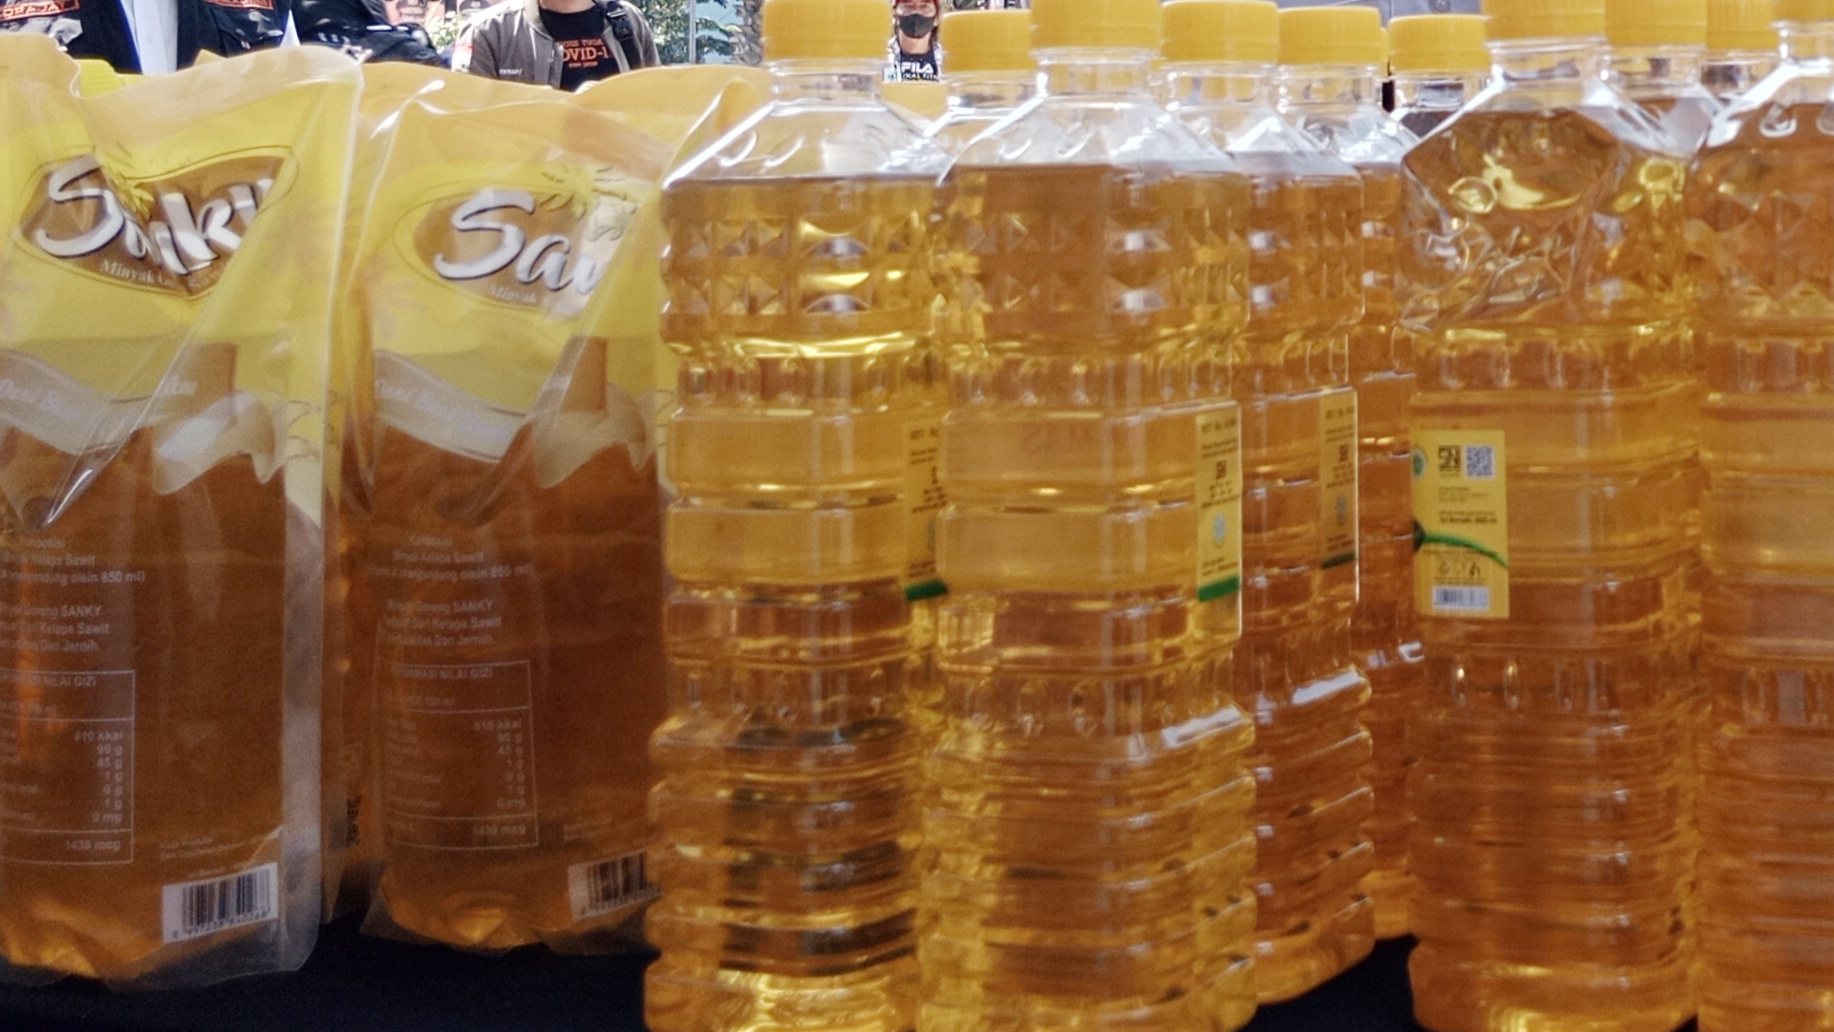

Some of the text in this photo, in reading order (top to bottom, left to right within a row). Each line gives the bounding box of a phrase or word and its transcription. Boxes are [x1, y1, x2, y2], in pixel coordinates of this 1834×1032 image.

[560, 45, 610, 63] OVID-1
[901, 61, 934, 74] FILA
[100, 260, 155, 284] Minyak
[61, 604, 102, 617] SANKY
[452, 598, 494, 613] SANKY
[470, 615, 503, 628] Sawit
[77, 622, 110, 635] Sawit
